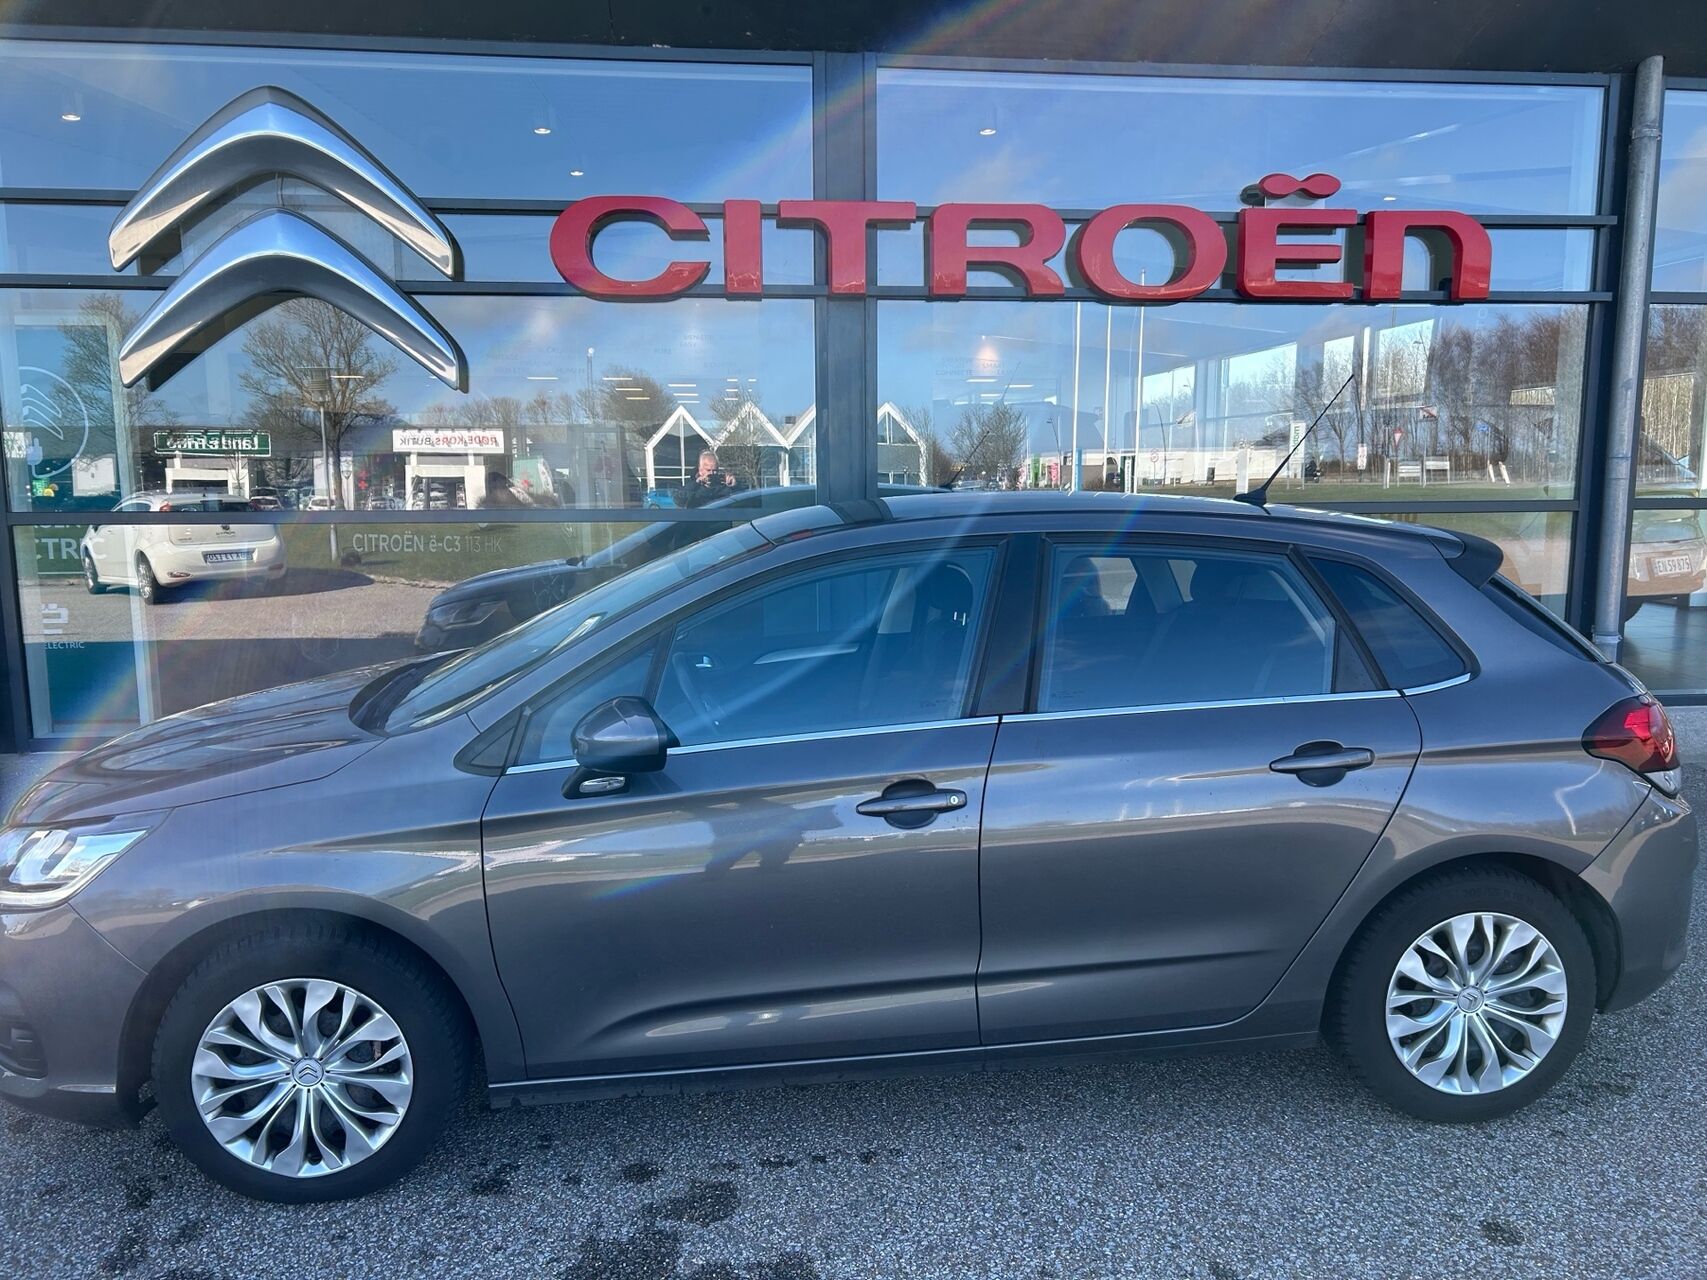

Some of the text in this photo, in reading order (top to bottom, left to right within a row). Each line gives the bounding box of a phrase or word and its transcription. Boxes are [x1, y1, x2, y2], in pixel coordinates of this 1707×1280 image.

[352, 530, 502, 553] CITROËN ë-C3 113 HK
